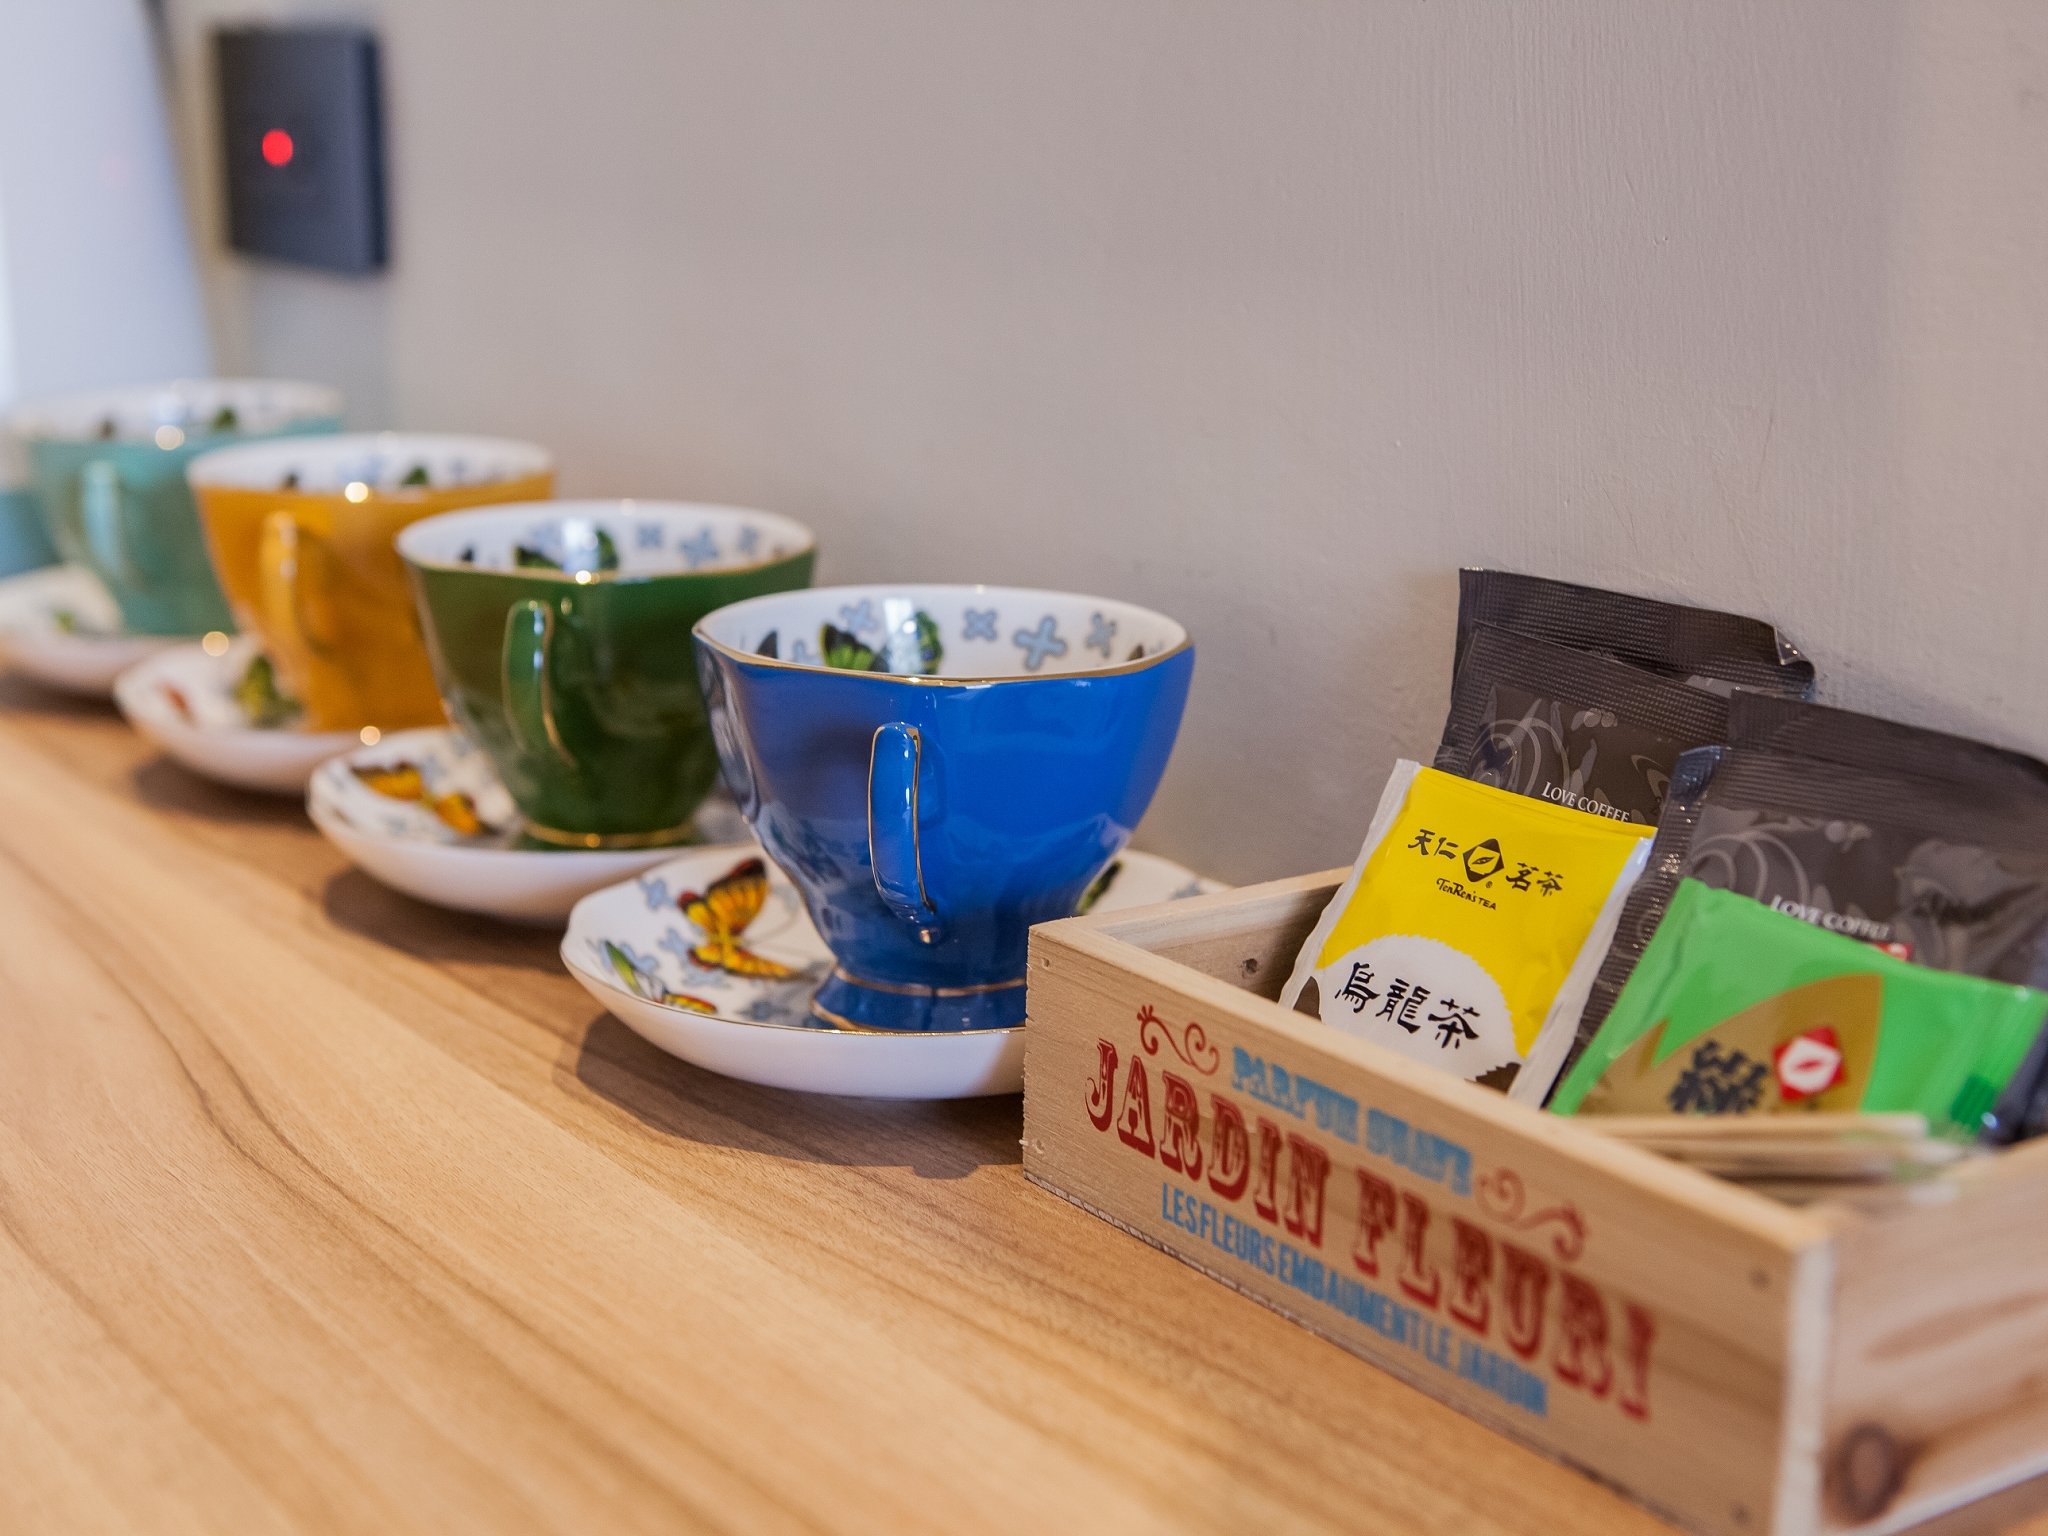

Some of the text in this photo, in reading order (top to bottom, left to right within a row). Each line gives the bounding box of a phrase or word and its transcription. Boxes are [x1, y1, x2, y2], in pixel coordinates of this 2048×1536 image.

[1542, 781, 1630, 823] LOVE COFFEE
[1407, 829, 1564, 897] 天仁 茗茶
[1478, 897, 1497, 910] TEA
[1770, 894, 1823, 925] LOVE
[1334, 961, 1481, 1049] 烏龍茶
[1084, 1037, 1657, 1424] JARDIN FLEURI
[1162, 1182, 1198, 1235] LES
[1199, 1202, 1275, 1276] FLEURS
